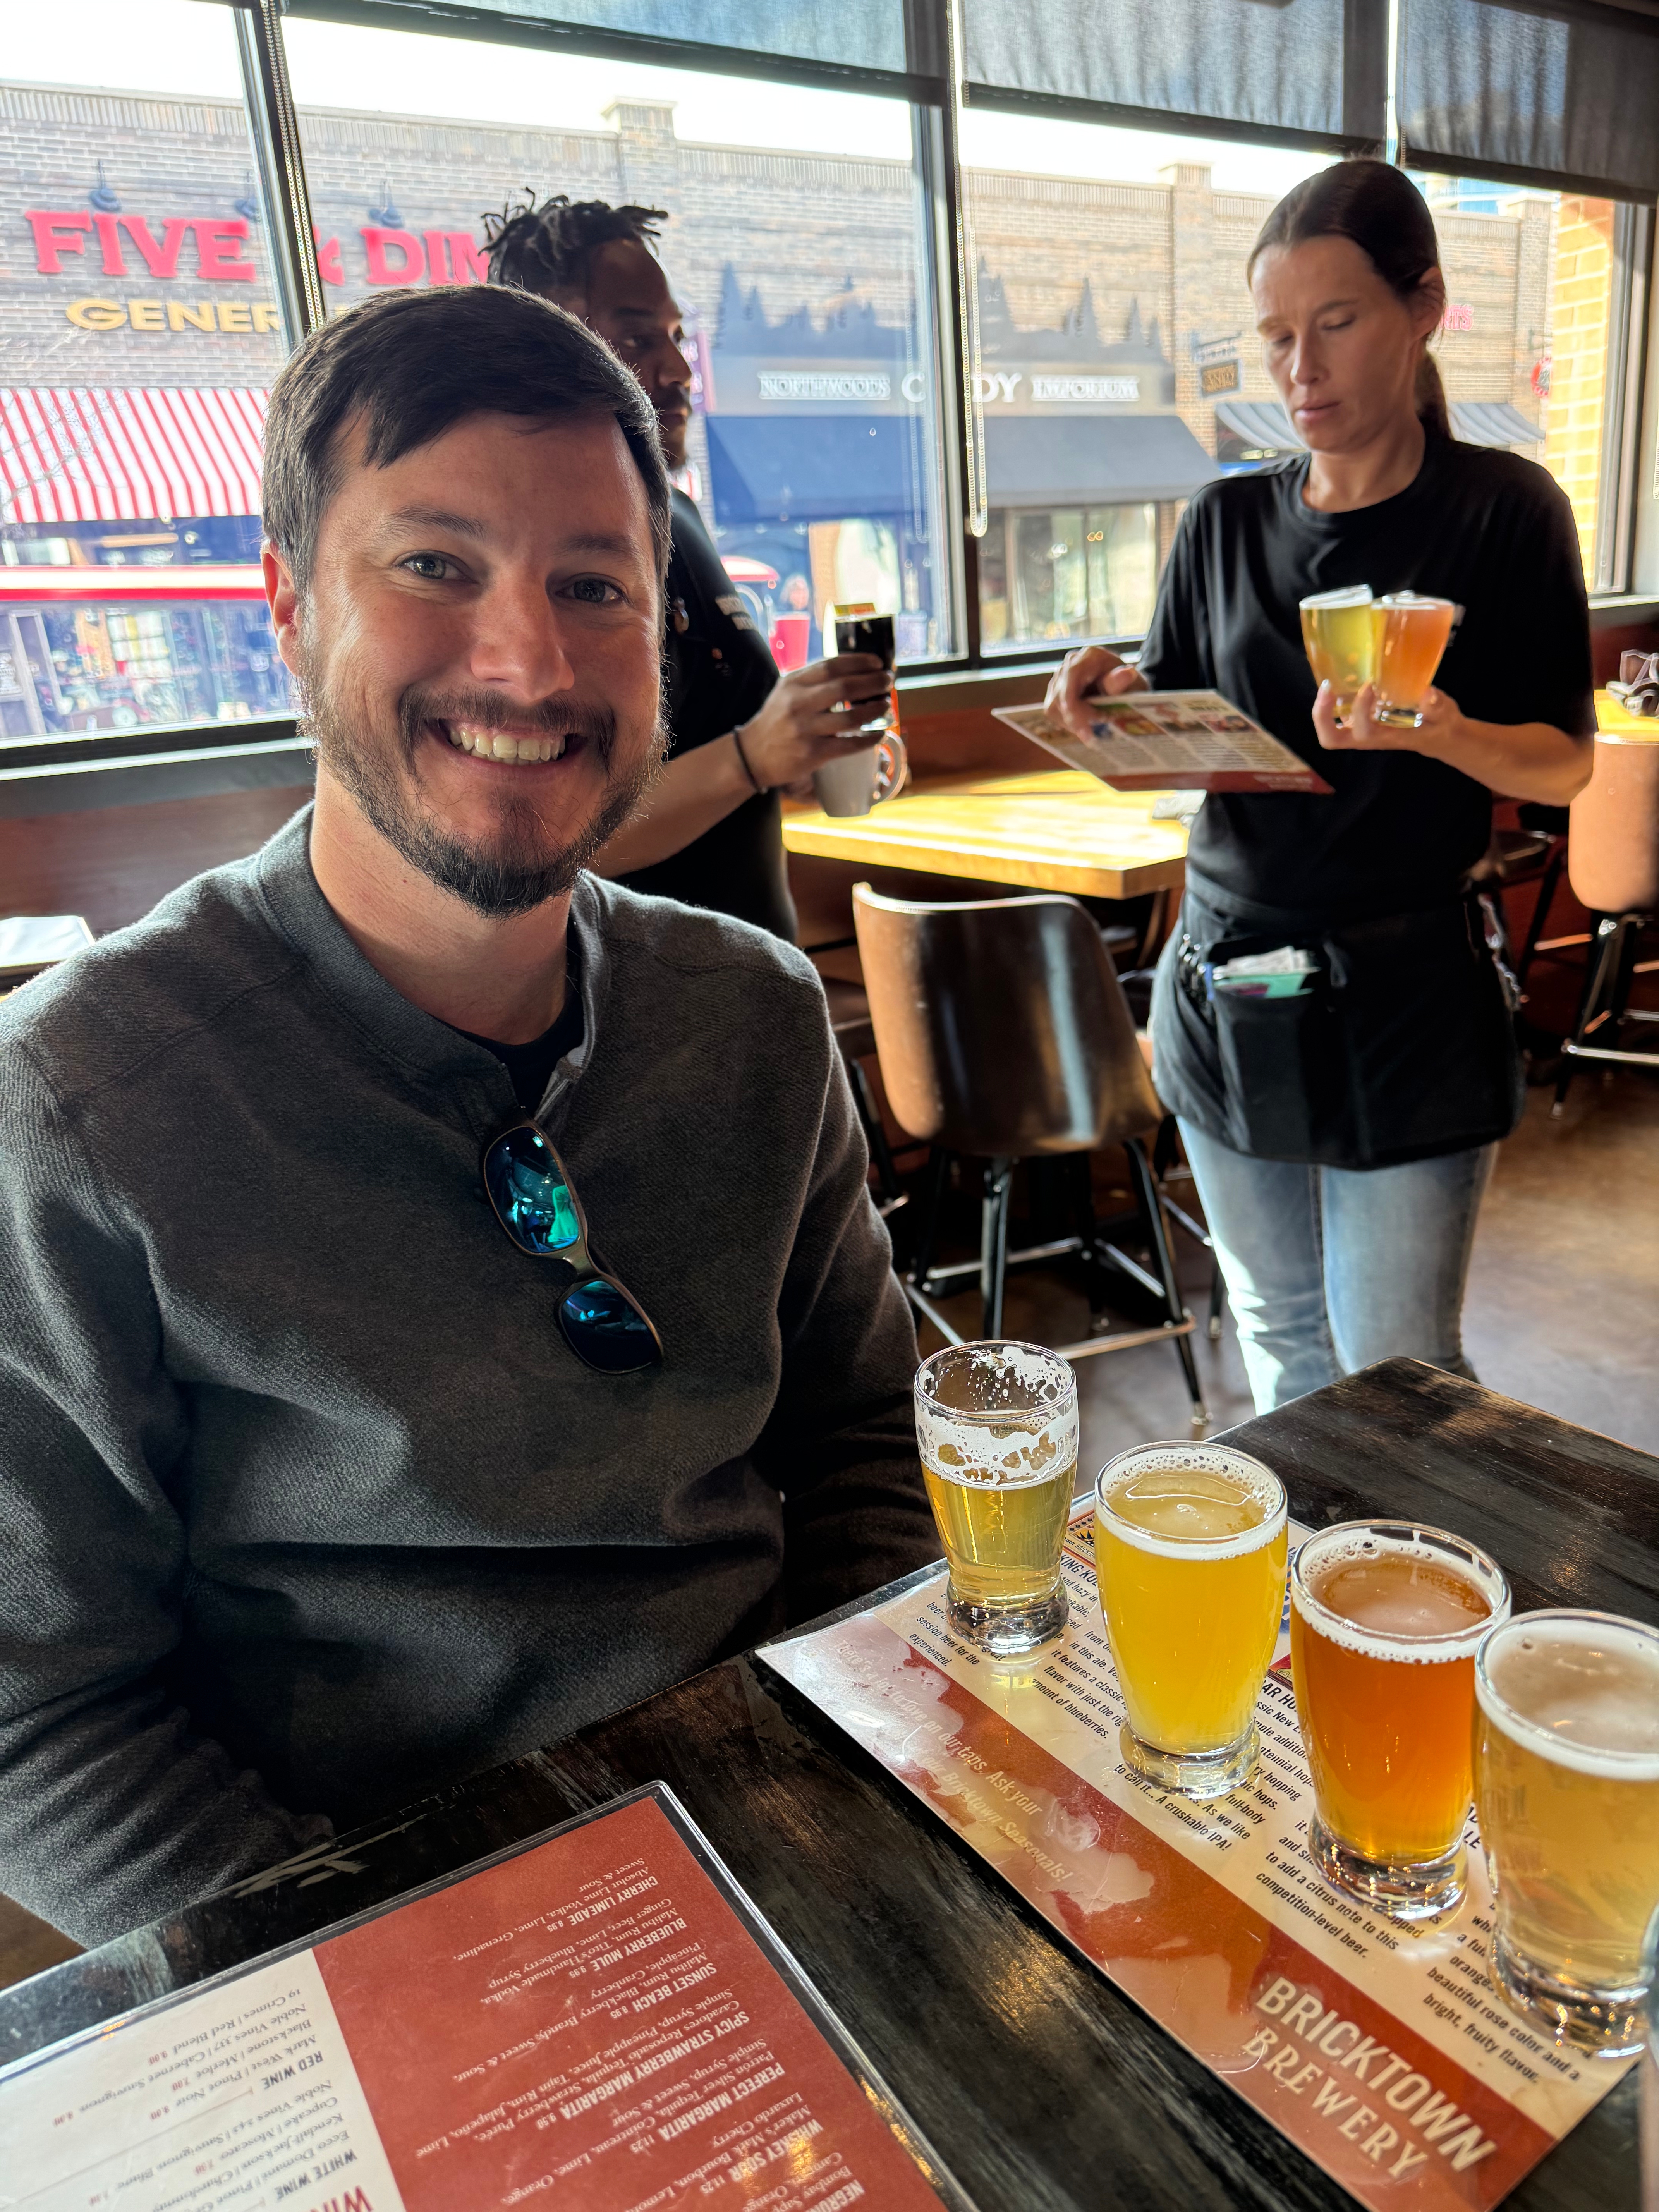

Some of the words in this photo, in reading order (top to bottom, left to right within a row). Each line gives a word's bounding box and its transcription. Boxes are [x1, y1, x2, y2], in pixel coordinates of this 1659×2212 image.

[24, 209, 258, 282] FIVE
[359, 227, 490, 286] DIM
[66, 298, 280, 333] GENER
[901, 372, 1022, 403] CDY
[1071, 1583, 1091, 1597] hazy
[908, 1633, 953, 1667] experienced.
[915, 1616, 943, 1637] session
[939, 1634, 958, 1648] beer
[954, 1645, 969, 1656] for
[965, 1654, 980, 1666] the
[1077, 1647, 1094, 1659] this
[1092, 1657, 1107, 1670] ale.
[1043, 1666, 1068, 1684] flavor
[1065, 1681, 1085, 1696] with
[1078, 1694, 1101, 1708] just
[1097, 1704, 1114, 1717] the
[1057, 1654, 1091, 1678] features
[1094, 1681, 1123, 1702] classic
[1055, 1698, 1070, 1706] of
[1063, 1703, 1109, 1739] blueberries.
[985, 1770, 1015, 1794] Ask
[1004, 1790, 1043, 1815] your
[1252, 1788, 1278, 1810] hops.
[1262, 1772, 1302, 1802] hopping
[1113, 1764, 1132, 1774] to
[1155, 1795, 1168, 1805] A
[1164, 1802, 1209, 1835] crushable
[1207, 1832, 1232, 1851] IPA!
[1224, 1793, 1266, 1825] full-body
[937, 1772, 1003, 1824] Bricktown
[998, 1822, 1073, 1882] Seasonals!
[1201, 1803, 1218, 1816] As
[1216, 1813, 1233, 1827] we
[1230, 1823, 1251, 1840] like
[602, 1872, 613, 1880] &
[610, 1866, 648, 1888] Absolut
[614, 1857, 645, 1874] Sweet
[578, 1877, 603, 1892] Sour
[583, 1886, 611, 1901] Lime
[616, 1875, 658, 1903] CHERRY
[545, 1900, 584, 1917] Vodka,
[566, 1896, 616, 1926] LIMEADE
[635, 1898, 672, 1919] Ginger
[1265, 1851, 1279, 1864] to
[1276, 1862, 1301, 1878] add
[1296, 1876, 1307, 1884] a
[1305, 1882, 1338, 1906] citrus
[1335, 1903, 1362, 1924] note
[1362, 1921, 1376, 1934] to
[1375, 1930, 1399, 1950] this
[513, 1915, 546, 1932] Lime,
[546, 1920, 564, 1932] 8.95
[606, 1916, 636, 1931] Beer,
[641, 1907, 678, 1929] Malibu
[1255, 1873, 1344, 1937] competition-level
[1339, 1932, 1369, 1958] beer.
[452, 1931, 514, 1961] Grenadine,
[575, 1929, 608, 1946] Lime,
[611, 1926, 641, 1941] Rum,
[623, 1917, 687, 1956] BLUEBERRY
[523, 1944, 575, 1973] Blueberry
[589, 1948, 623, 1972] MULE
[644, 1942, 701, 1970] Pineapple,
[669, 1951, 708, 1974] Malibu
[488, 1969, 522, 1988] Syrup
[520, 1955, 584, 1987] Handmade
[568, 1965, 586, 1978] 9.95
[591, 1970, 646, 1999] Cranberry
[638, 1971, 670, 1987] Rum,
[672, 1962, 717, 1992] SUNSET
[479, 1985, 521, 2004] Vodka,
[579, 1986, 639, 2019] Blackberry
[631, 1984, 673, 2012] BEACH
[694, 1988, 733, 2010] Simple
[609, 2005, 628, 2019] 8.95
[657, 2007, 695, 2027] Syrup,
[682, 2000, 740, 2031] Cazadores
[713, 2010, 749, 2037] SPICY
[1426, 1966, 1483, 2010] beautiful
[1479, 2007, 1509, 2030] rose
[1509, 2028, 1544, 2053] color
[1542, 2053, 1572, 2073] and
[1569, 2072, 1580, 2081] a
[499, 2037, 538, 2060] Sweet
[602, 2026, 658, 2057] Pineapple
[627, 2028, 683, 2059] Reposado
[726, 2038, 767, 2062] Simple
[1422, 1993, 1462, 2028] bright,
[1463, 2023, 1499, 2054] fruity
[1498, 2049, 1539, 2084] flavor.
[485, 2056, 498, 2066] &
[567, 2051, 602, 2074] Juice,
[634, 2029, 714, 2080] STRAWBERRY
[734, 2050, 775, 2074] Patrón
[452, 2063, 485, 2082] Sour,
[537, 2073, 570, 2092] Tajín
[580, 2058, 629, 2083] Tequila,
[688, 2058, 727, 2080] Syrup,
[703, 2071, 735, 2092] Silver
[731, 2061, 785, 2100] PERFECT
[1256, 1977, 1497, 2171] BRICKTOWN
[505, 2089, 538, 2107] Rim,
[516, 2081, 581, 2121] Strawberry
[559, 2070, 634, 2120] MARGARITA
[653, 2078, 690, 2102] Sweet
[654, 2090, 701, 2116] Tequila,
[1242, 2028, 1428, 2179] BREWERY
[611, 2106, 641, 2127] Sour
[640, 2099, 653, 2110] &
[657, 2091, 732, 2141] MARGARITA
[753, 2091, 803, 2123] Luxardo
[449, 2101, 506, 2138] Jalapeño,
[473, 2117, 515, 2141] Purée,
[536, 2112, 556, 2130] 9.50
[764, 2104, 811, 2134] Maker's
[416, 2136, 449, 2158] Lime
[589, 2116, 655, 2154] Cointreau,
[630, 2134, 654, 2153] 11.25
[711, 2120, 754, 2148] Cherry
[732, 2132, 764, 2154] Mark
[553, 2152, 591, 2176] Lime,
[673, 2151, 732, 2187] Bourbon,
[728, 2152, 766, 2183] SOUR
[500, 2174, 554, 2206] Orange,
[699, 2174, 725, 2195] 11.25
